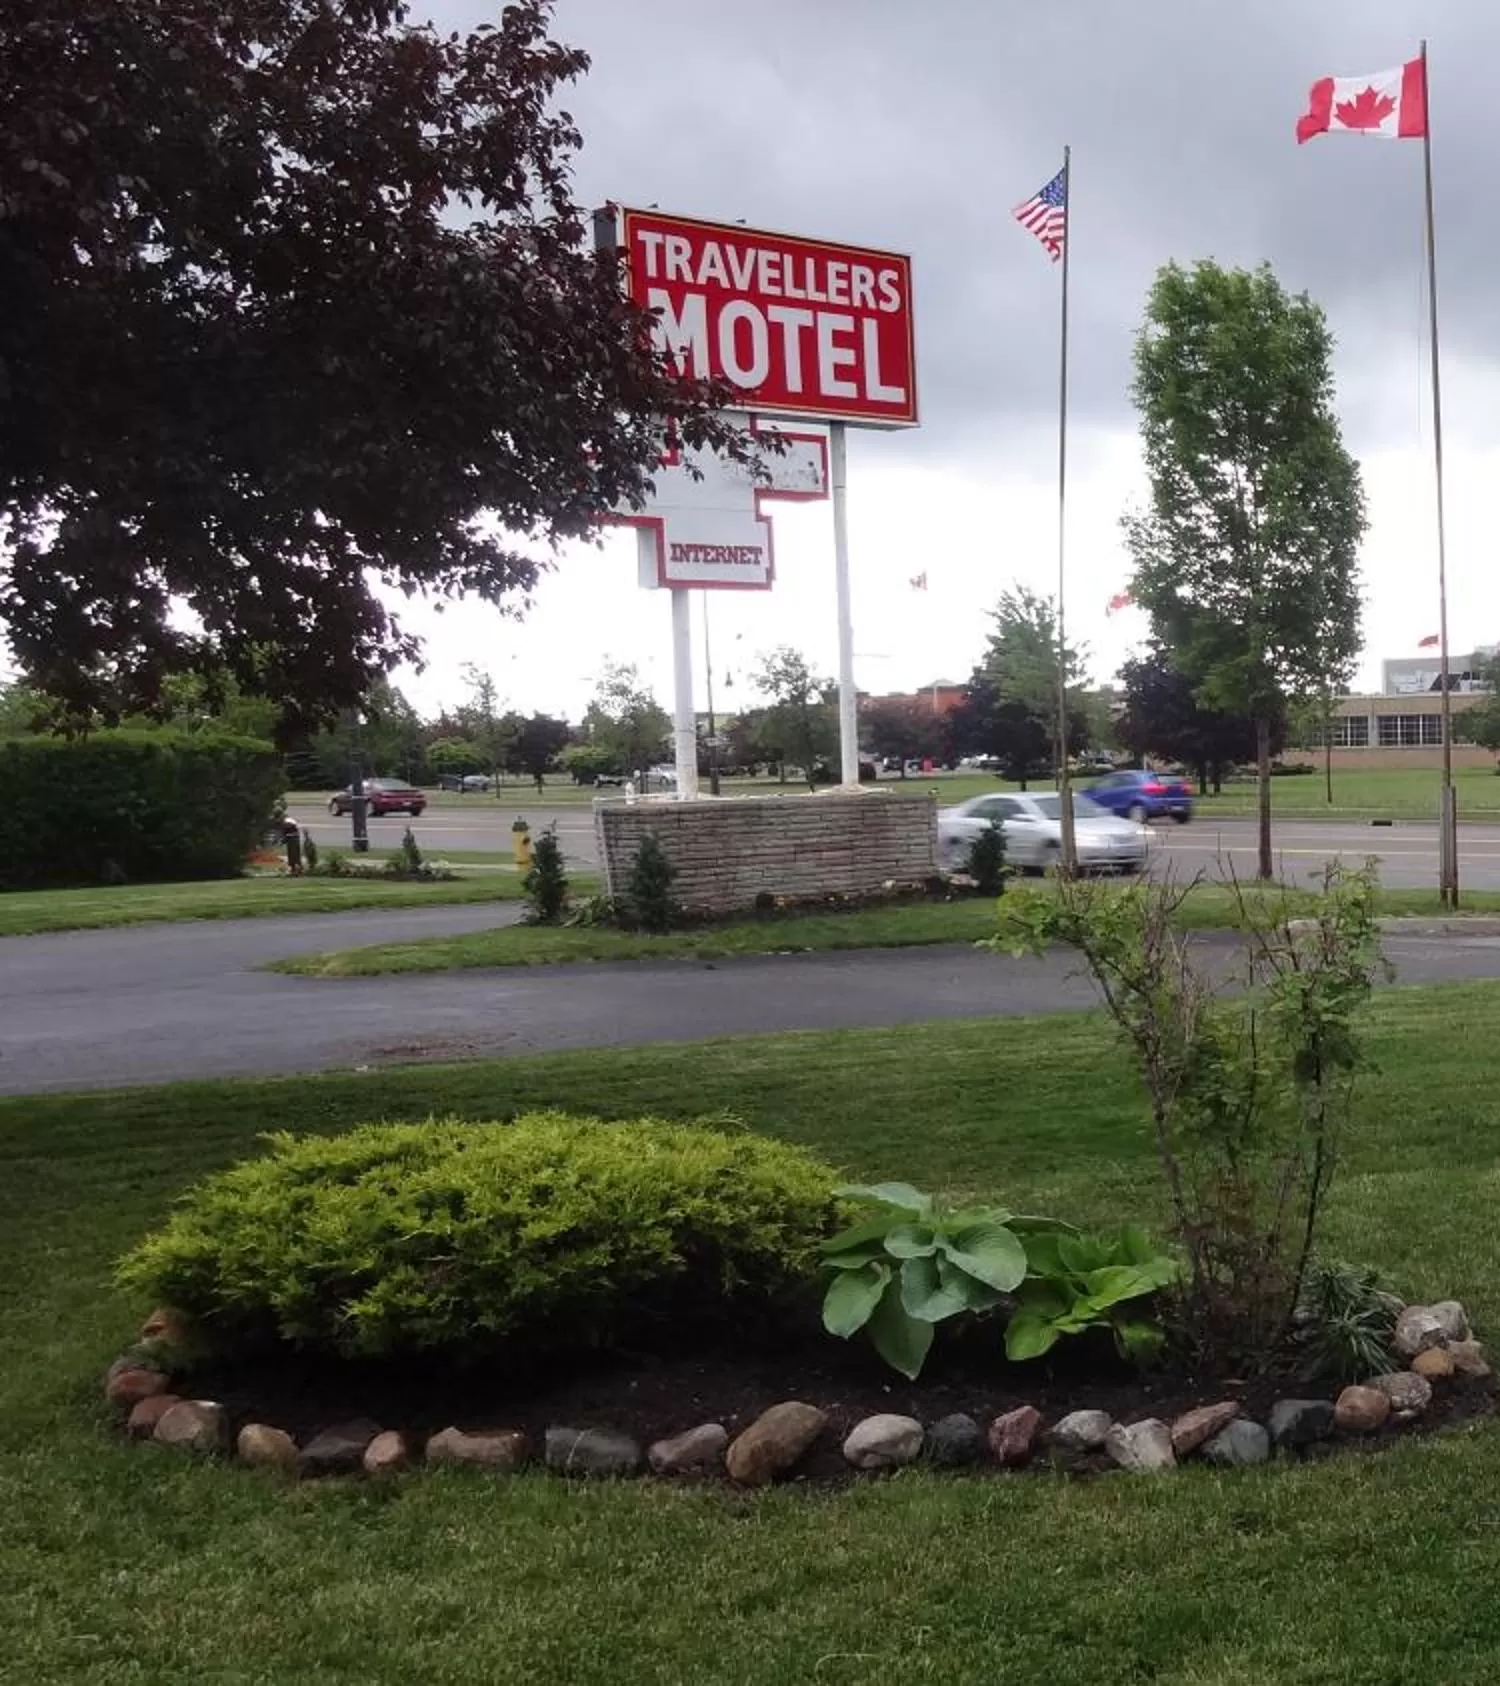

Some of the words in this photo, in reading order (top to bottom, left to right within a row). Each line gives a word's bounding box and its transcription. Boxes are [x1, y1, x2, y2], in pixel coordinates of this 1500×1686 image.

[638, 230, 902, 312] TRAVELLERS
[647, 289, 907, 404] MOTEL
[670, 543, 763, 565] INTERNET
